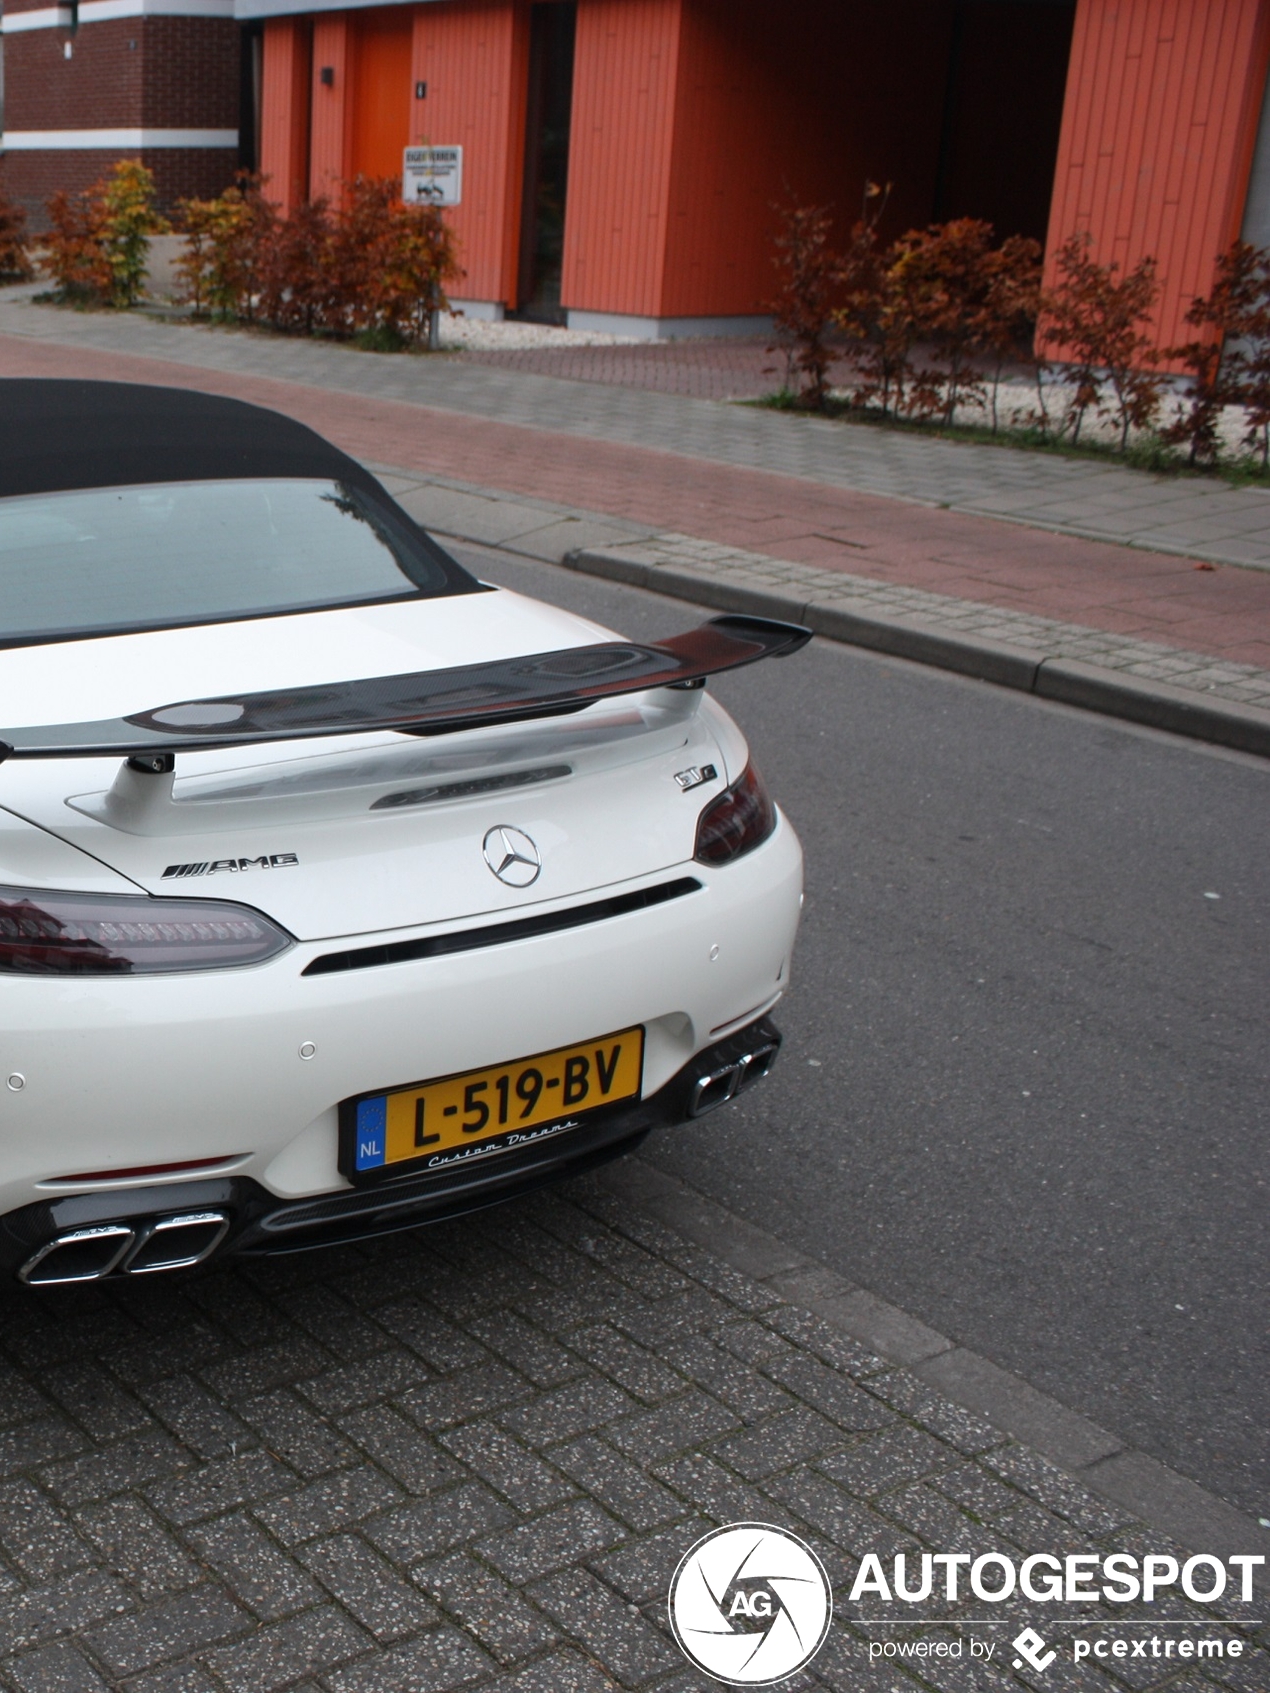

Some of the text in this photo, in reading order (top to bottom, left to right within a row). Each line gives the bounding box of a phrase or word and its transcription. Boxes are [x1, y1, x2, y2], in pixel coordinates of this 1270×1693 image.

[208, 853, 299, 876] AMG
[414, 1044, 621, 1148] L-519-BV
[360, 1142, 380, 1158] NL
[428, 1121, 578, 1167] Custom Dreams
